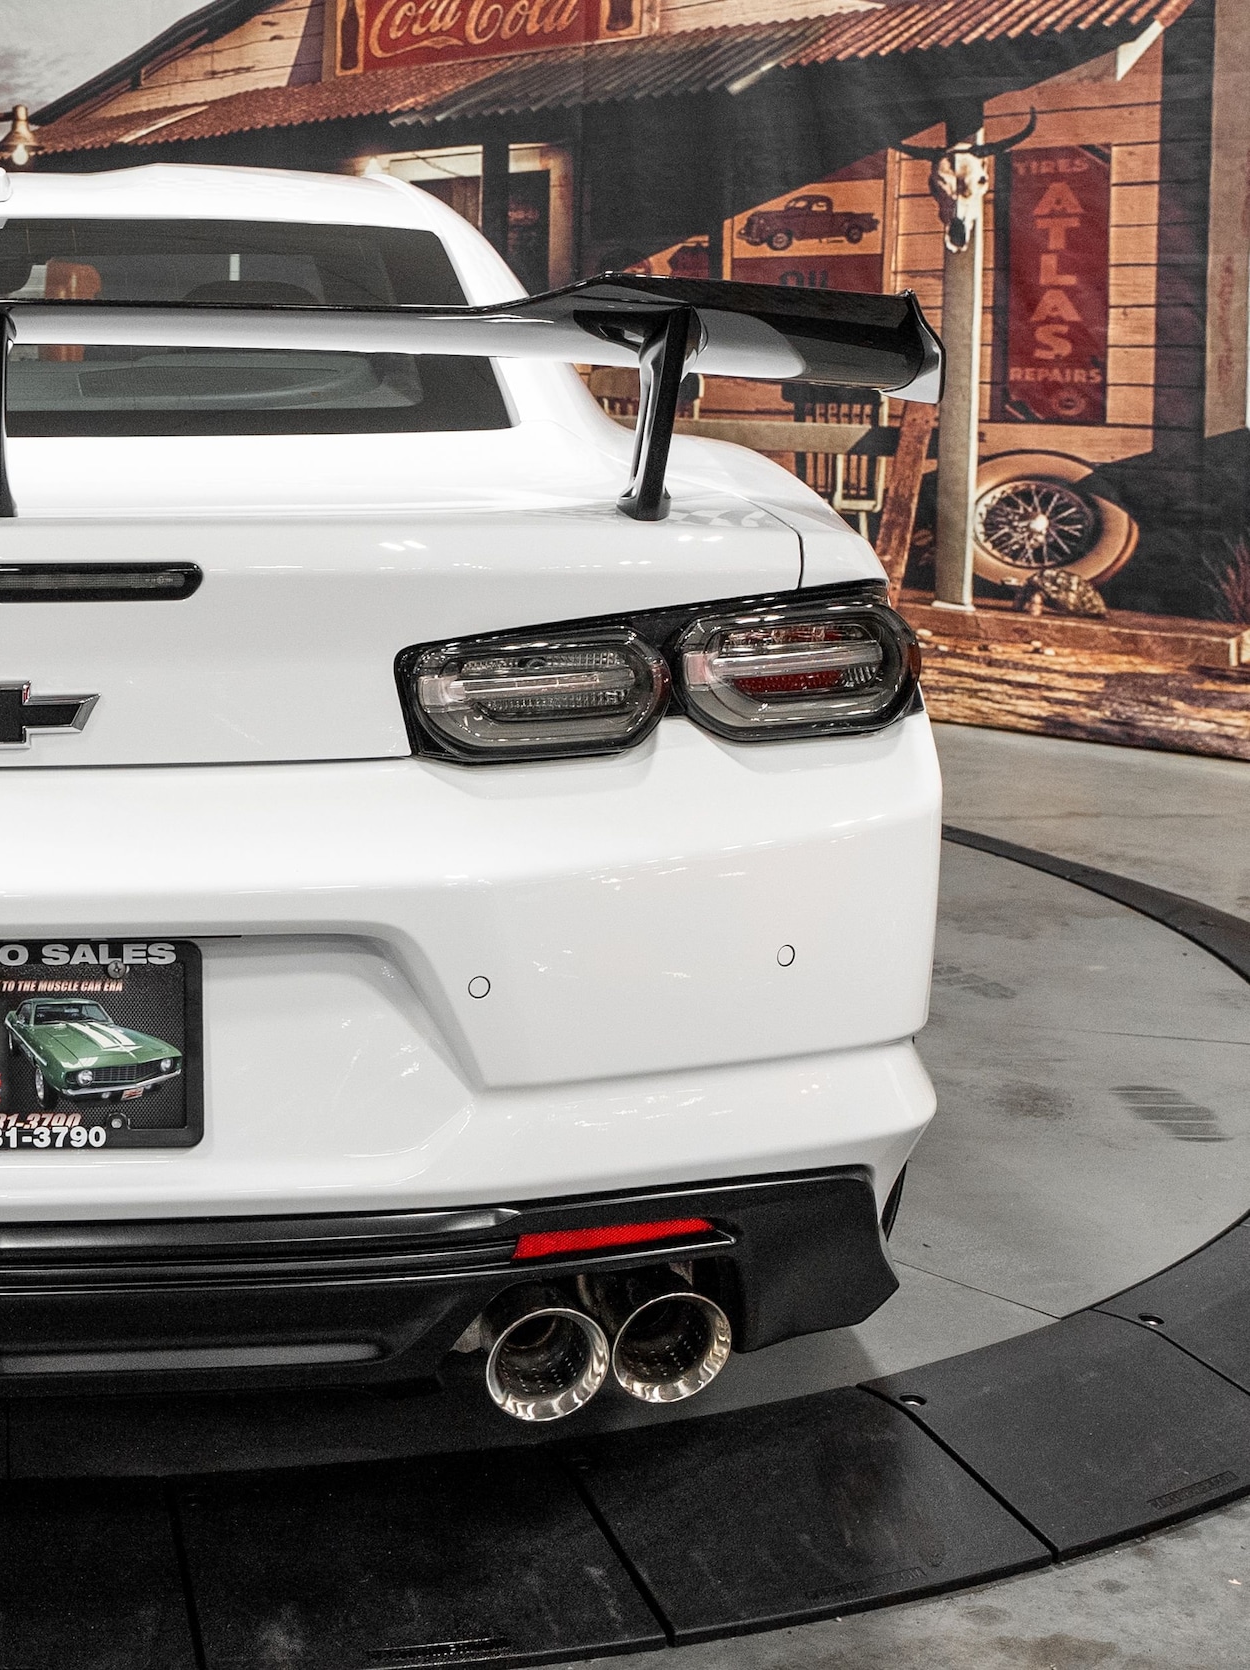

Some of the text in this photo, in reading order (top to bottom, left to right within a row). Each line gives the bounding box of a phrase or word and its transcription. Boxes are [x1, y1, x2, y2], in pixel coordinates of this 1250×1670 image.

[1012, 157, 1090, 176] TIRES
[1028, 180, 1086, 361] ATLAS
[1009, 366, 1103, 384] REPAIRS
[41, 942, 177, 966] SALES
[1, 979, 16, 992] TO
[17, 979, 38, 993] THE
[37, 979, 79, 993] MUSCLE
[80, 979, 103, 993] CAR
[103, 979, 124, 993] ERA
